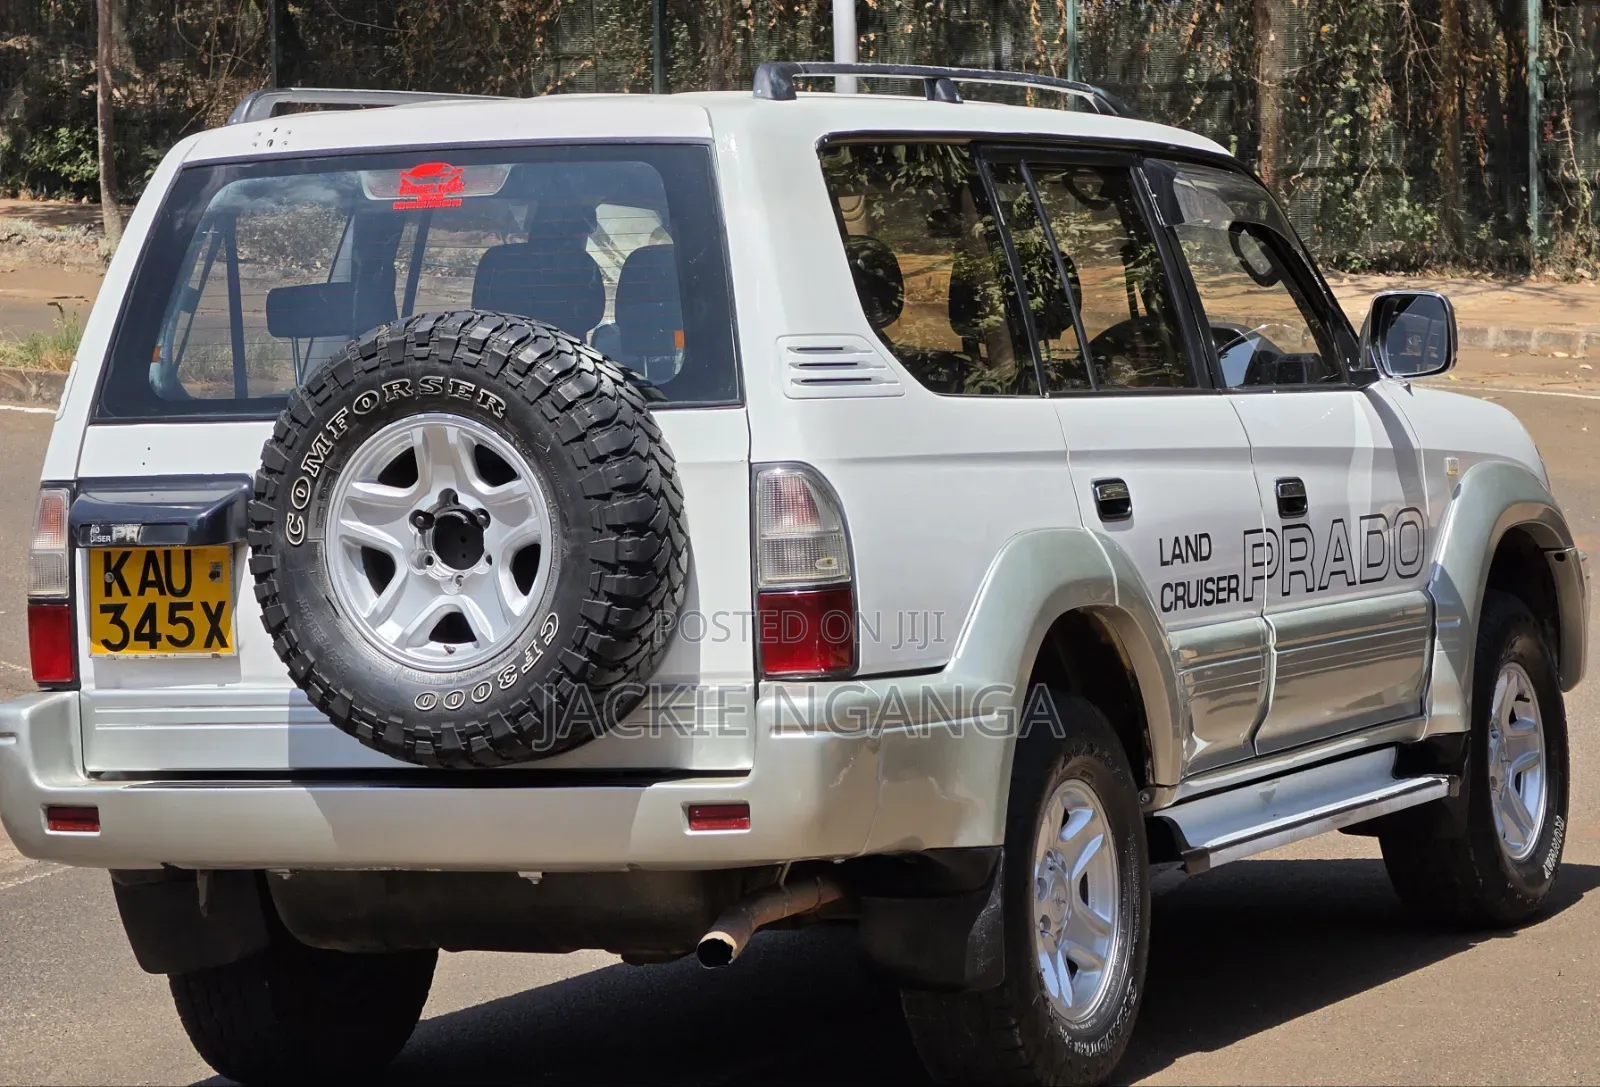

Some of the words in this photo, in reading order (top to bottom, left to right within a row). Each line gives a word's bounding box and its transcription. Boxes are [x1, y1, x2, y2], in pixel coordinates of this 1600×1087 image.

[285, 376, 507, 546] COMFORSER
[103, 549, 193, 598] KAU
[1159, 532, 1212, 567] LAND
[1243, 507, 1425, 603] PRADO
[1160, 574, 1240, 613] CRUISER
[99, 600, 229, 652] 345X
[414, 612, 559, 711] CF3000
